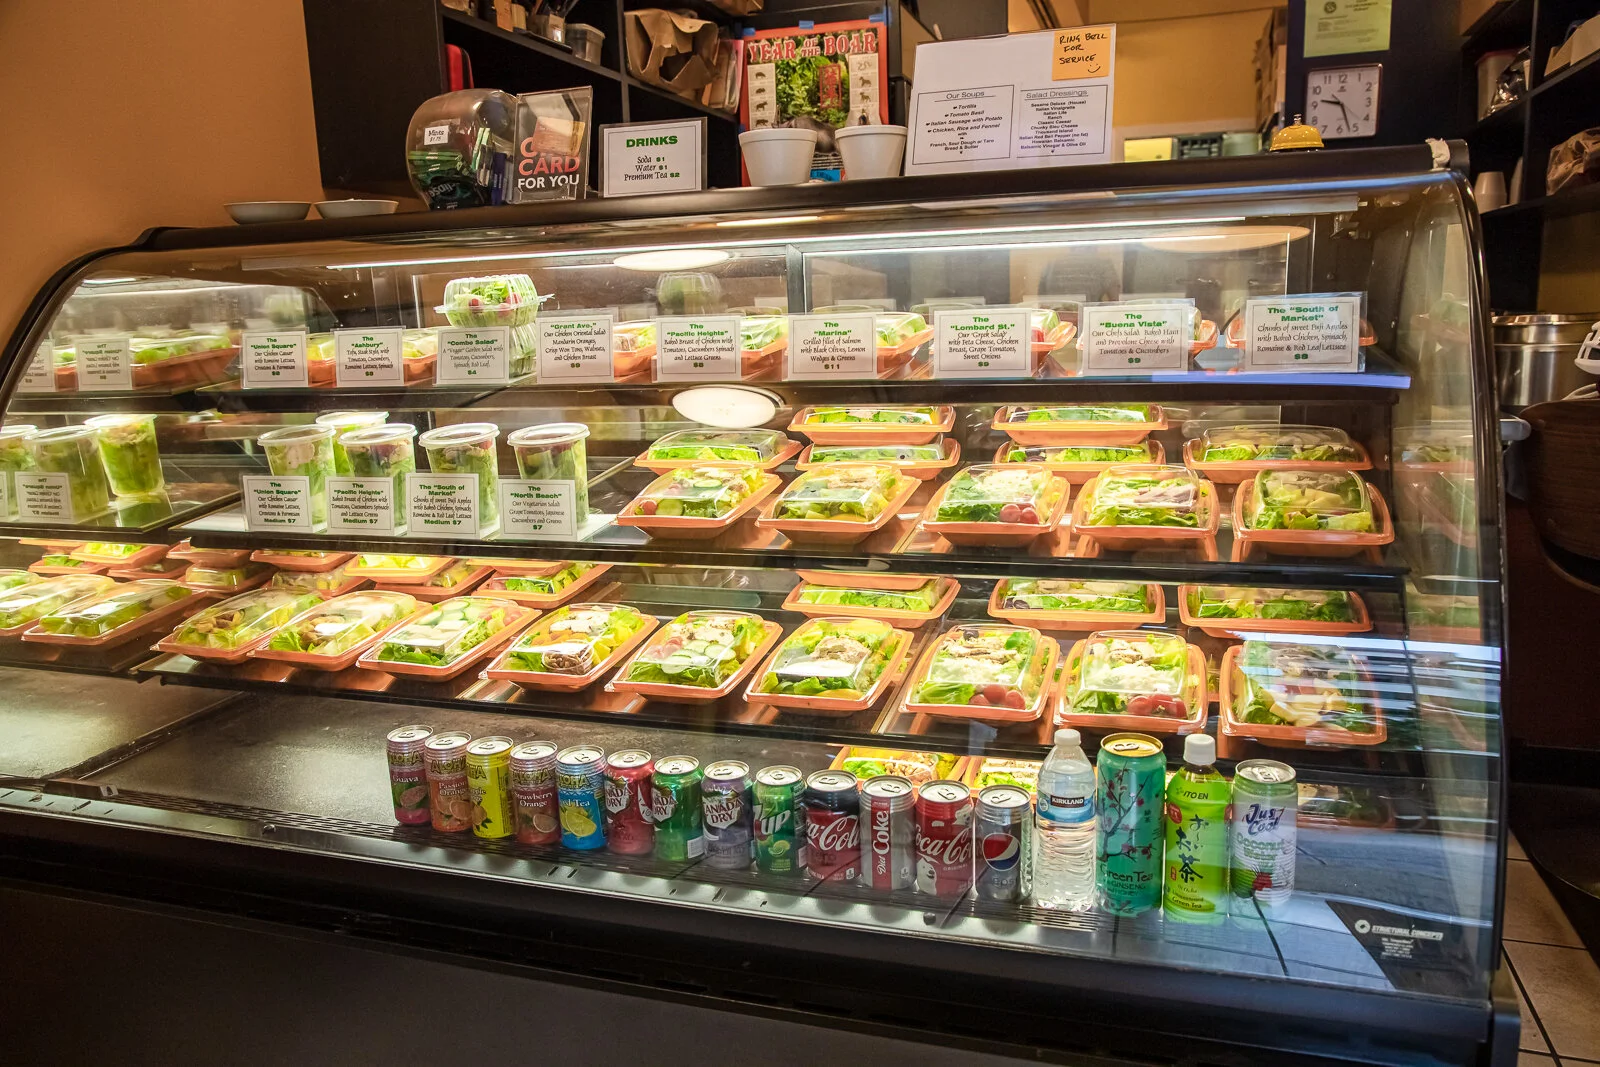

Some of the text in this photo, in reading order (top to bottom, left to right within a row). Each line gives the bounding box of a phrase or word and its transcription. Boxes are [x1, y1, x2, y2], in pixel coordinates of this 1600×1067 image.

[1060, 34, 1080, 44] RING
[749, 32, 877, 63] YEAR OF THE BOAR
[1064, 44, 1084, 52] FOR
[1059, 54, 1096, 64] SERVICE
[1324, 75, 1331, 84] 11
[1339, 74, 1347, 83] 12
[1313, 86, 1321, 95] 10
[1366, 82, 1372, 91] 2
[1311, 101, 1318, 109] 9
[1366, 97, 1371, 107] 3
[1311, 116, 1318, 125] 8
[1322, 125, 1328, 134] 7
[1336, 125, 1343, 133] 6
[1353, 123, 1359, 132] 5
[626, 136, 678, 147] DRINKS
[519, 156, 580, 175] CARD
[624, 172, 653, 181] Premium
[518, 174, 579, 189] FOR YOU
[1258, 323, 1281, 331] Chunks
[1283, 323, 1289, 332] of
[1326, 321, 1348, 330] Apples
[996, 336, 1018, 344] Chicken
[1293, 333, 1319, 342] Chicken,
[969, 346, 986, 354] Grape
[988, 345, 1016, 353] Tomatoes,
[1308, 343, 1321, 352] Leaf
[1183, 791, 1197, 799] ITO
[711, 812, 733, 824] DRY
[873, 810, 890, 855] Coke
[1100, 863, 1153, 882] Green Tea
[1172, 897, 1190, 907] Green
